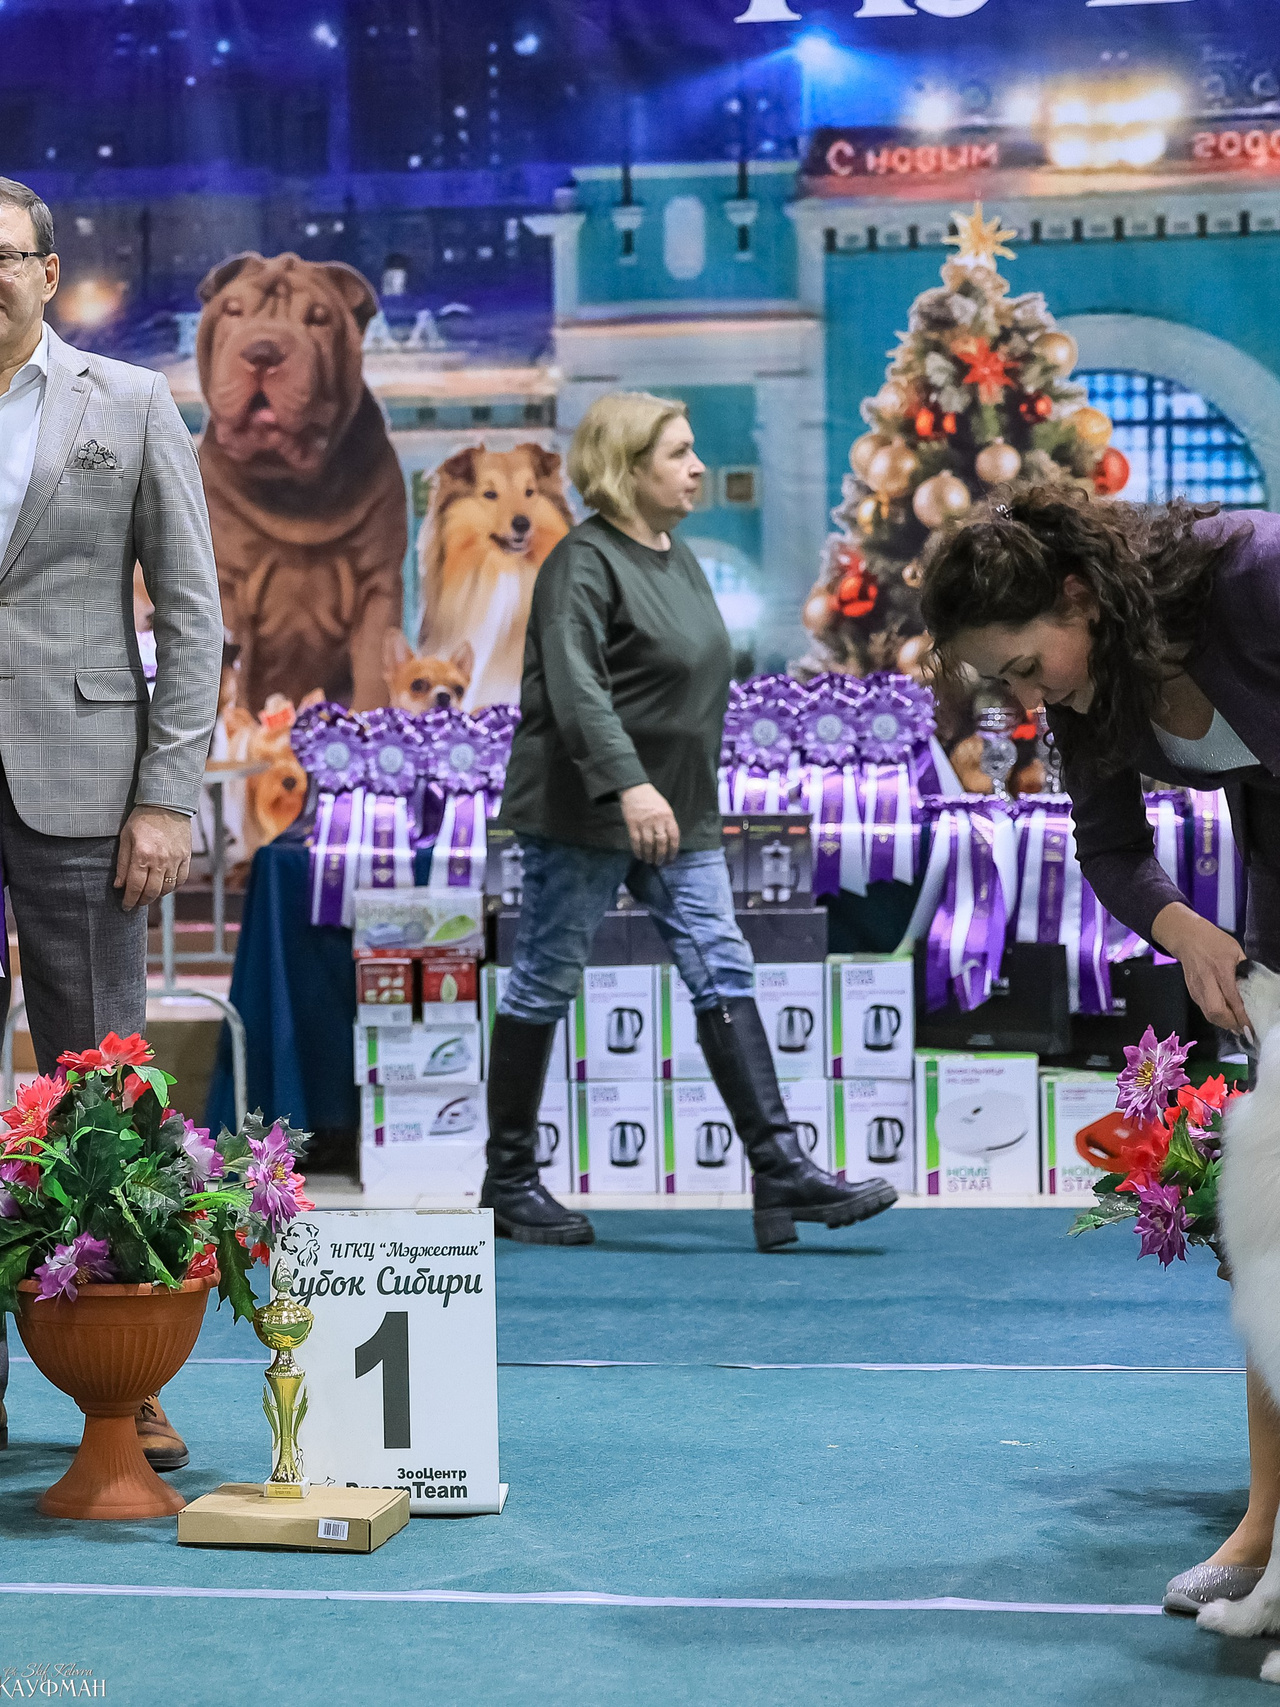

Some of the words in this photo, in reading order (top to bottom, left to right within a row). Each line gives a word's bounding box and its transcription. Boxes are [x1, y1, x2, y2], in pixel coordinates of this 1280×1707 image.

[826, 139, 855, 176] С
[946, 1166, 990, 1177] HOME
[946, 1178, 992, 1193] STAR
[330, 1242, 375, 1261] НГКЦ
[376, 1265, 483, 1308] Сибири
[354, 1311, 411, 1449] 1
[397, 1467, 467, 1482] ЗооЦентр
